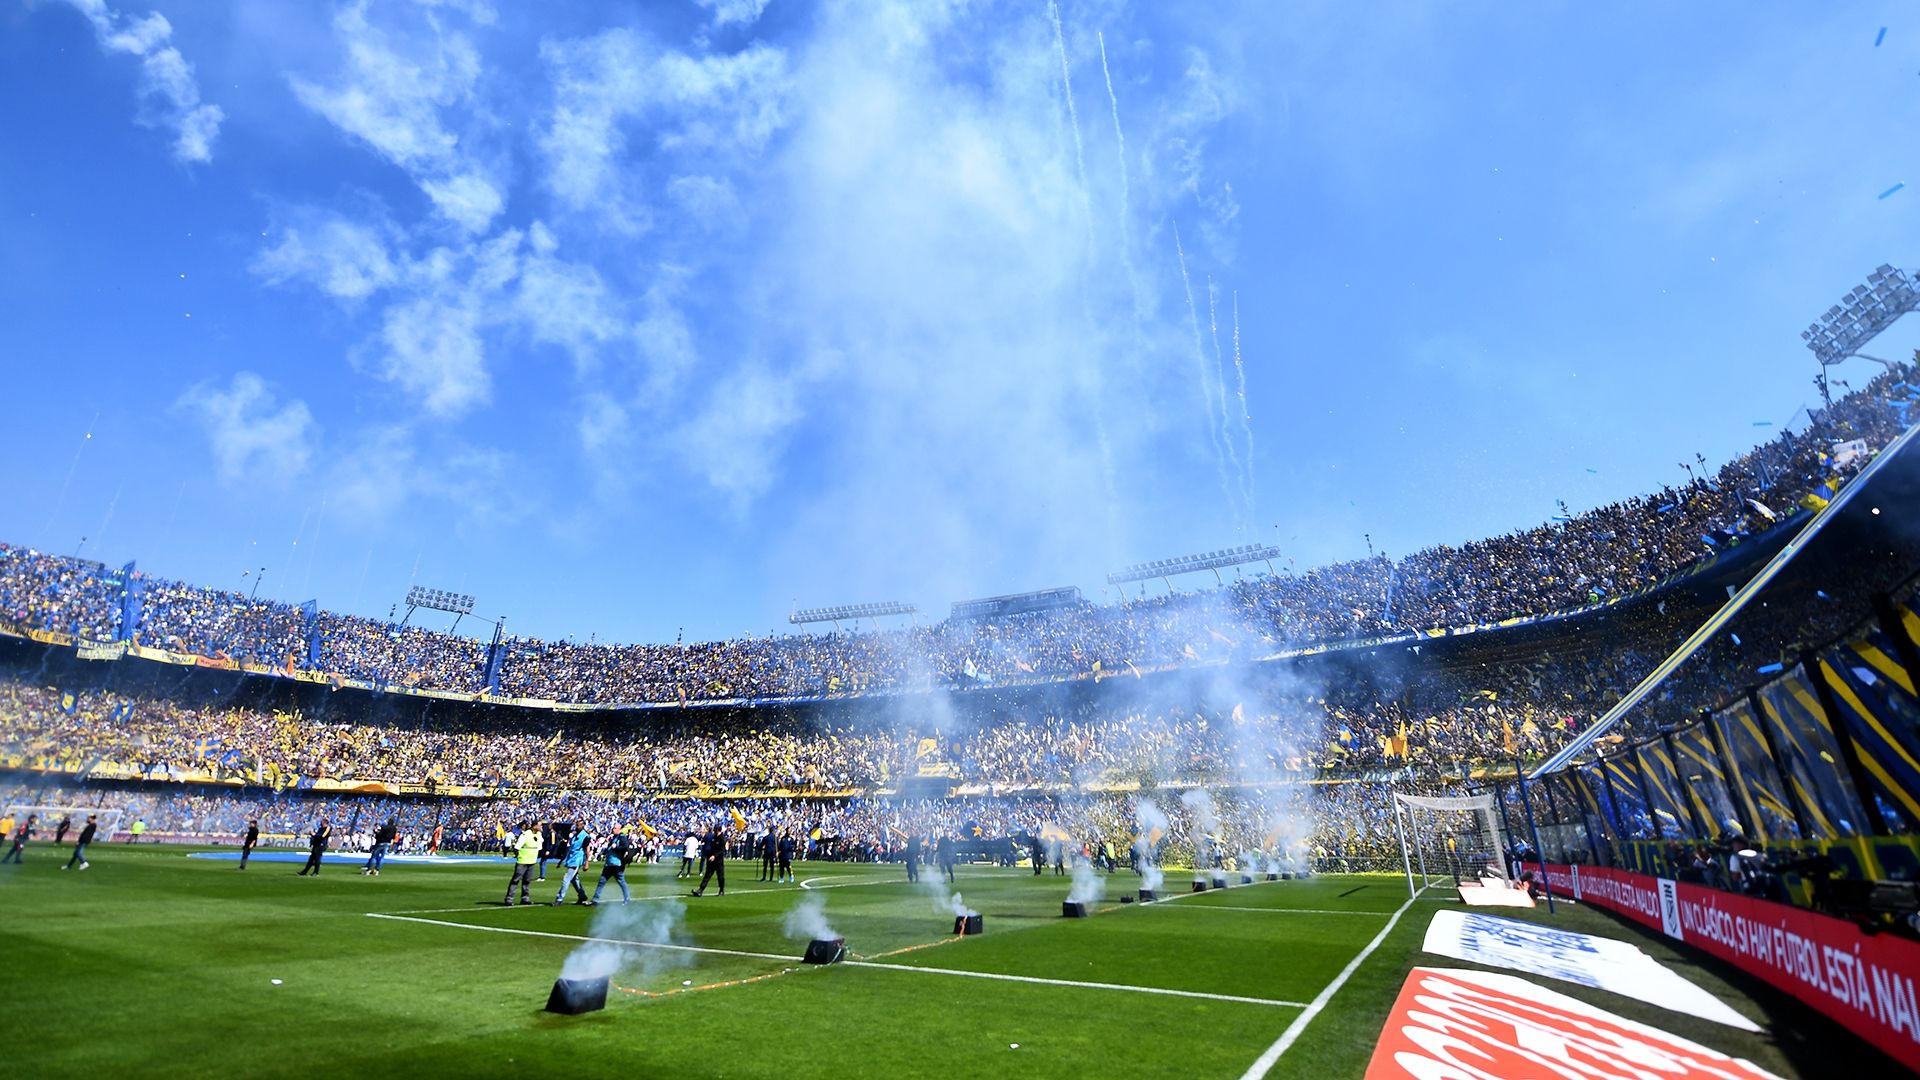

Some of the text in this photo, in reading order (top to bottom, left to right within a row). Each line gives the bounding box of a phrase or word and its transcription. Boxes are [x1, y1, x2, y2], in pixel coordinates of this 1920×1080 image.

[1736, 916, 1749, 954] SI
[1748, 919, 1773, 966] HAY
[1773, 919, 1828, 992] FÚTBOL
[1823, 941, 1876, 1018] ESTÁ
